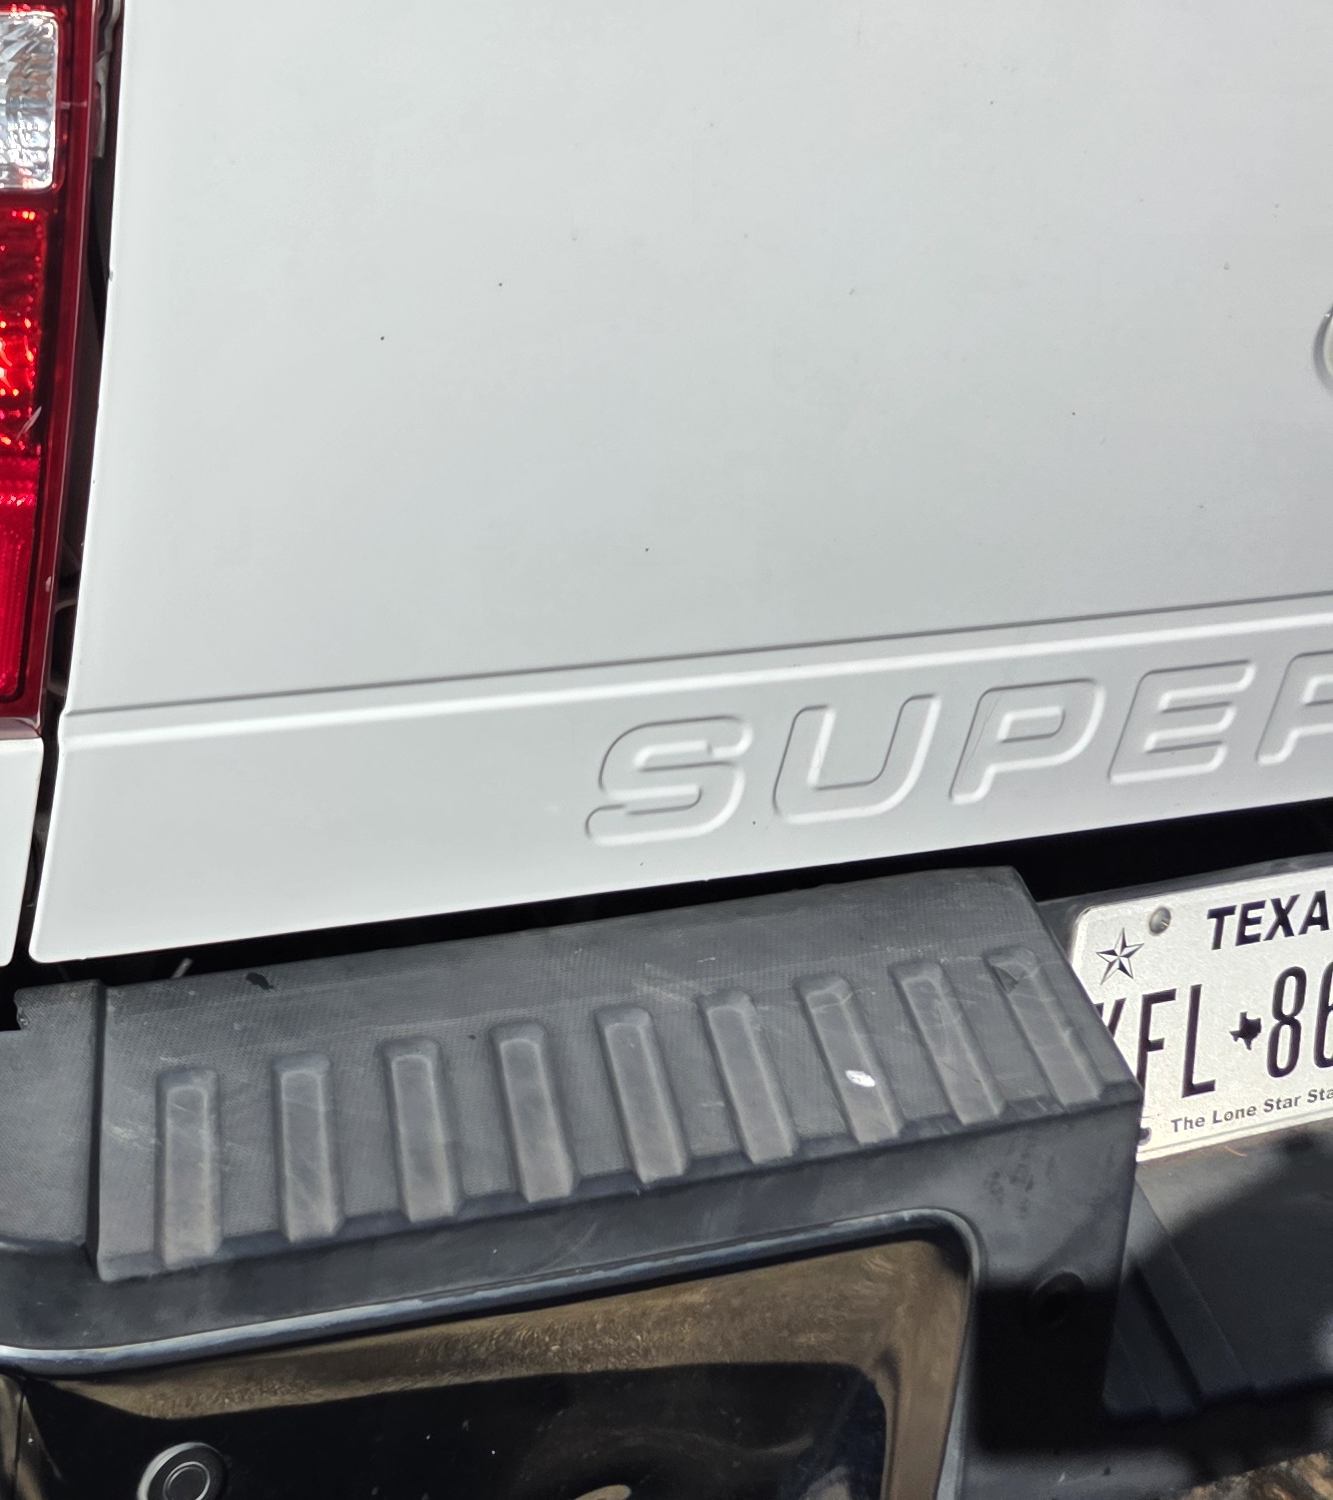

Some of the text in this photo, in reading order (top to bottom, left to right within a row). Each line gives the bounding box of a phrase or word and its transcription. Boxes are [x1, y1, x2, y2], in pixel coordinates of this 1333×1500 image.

[1206, 889, 1331, 951] TEXA
[1171, 1116, 1206, 1133] The
[1212, 1105, 1257, 1125] Lone
[1263, 1095, 1302, 1113] Star
